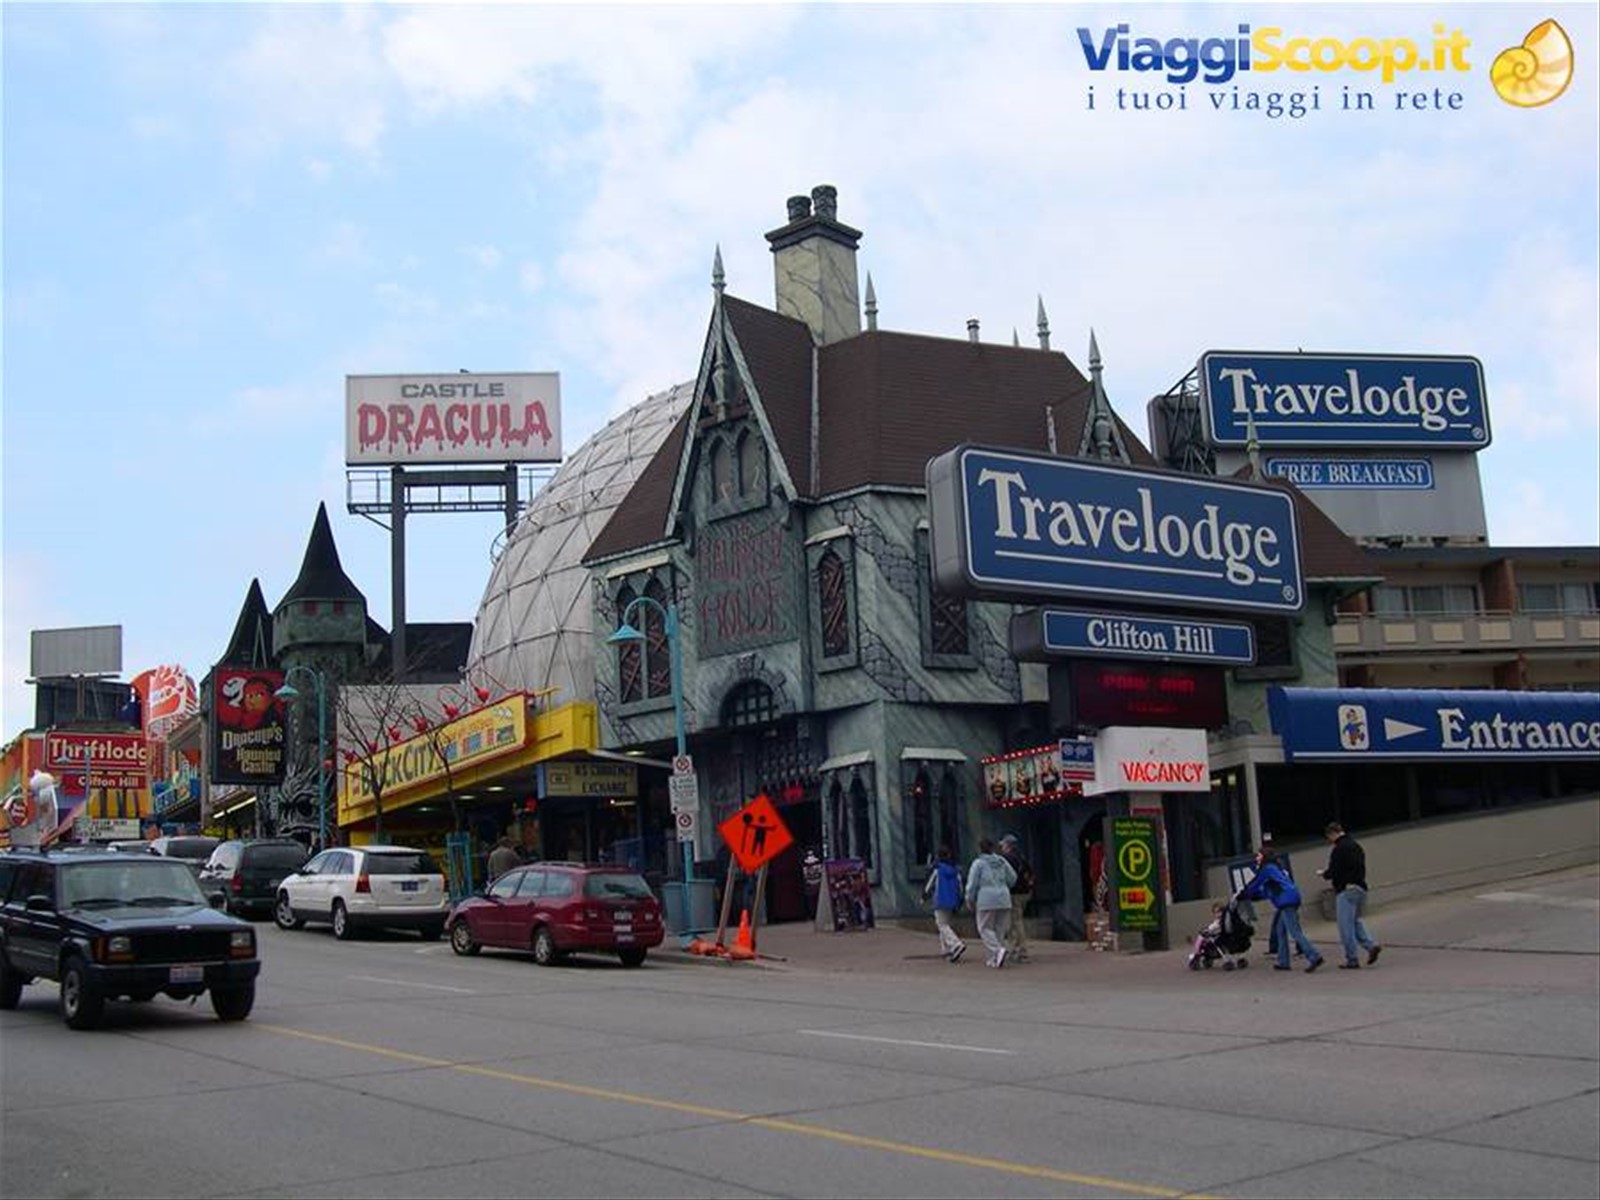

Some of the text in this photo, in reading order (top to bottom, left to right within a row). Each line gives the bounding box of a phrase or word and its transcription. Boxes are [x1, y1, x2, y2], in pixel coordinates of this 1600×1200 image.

[402, 382, 505, 398] CASTLE
[1219, 367, 1470, 431] Travelodge
[358, 401, 552, 455] DRACULA
[1277, 464, 1427, 484] FREE BREAKFAST
[978, 468, 1281, 586] Travelodge
[1086, 619, 1216, 654] Clifton Hill
[1437, 707, 1600, 752] Entrance
[78, 776, 139, 787] Cifton Hill
[1121, 761, 1206, 783] VACANCY
[1129, 847, 1145, 873] P
